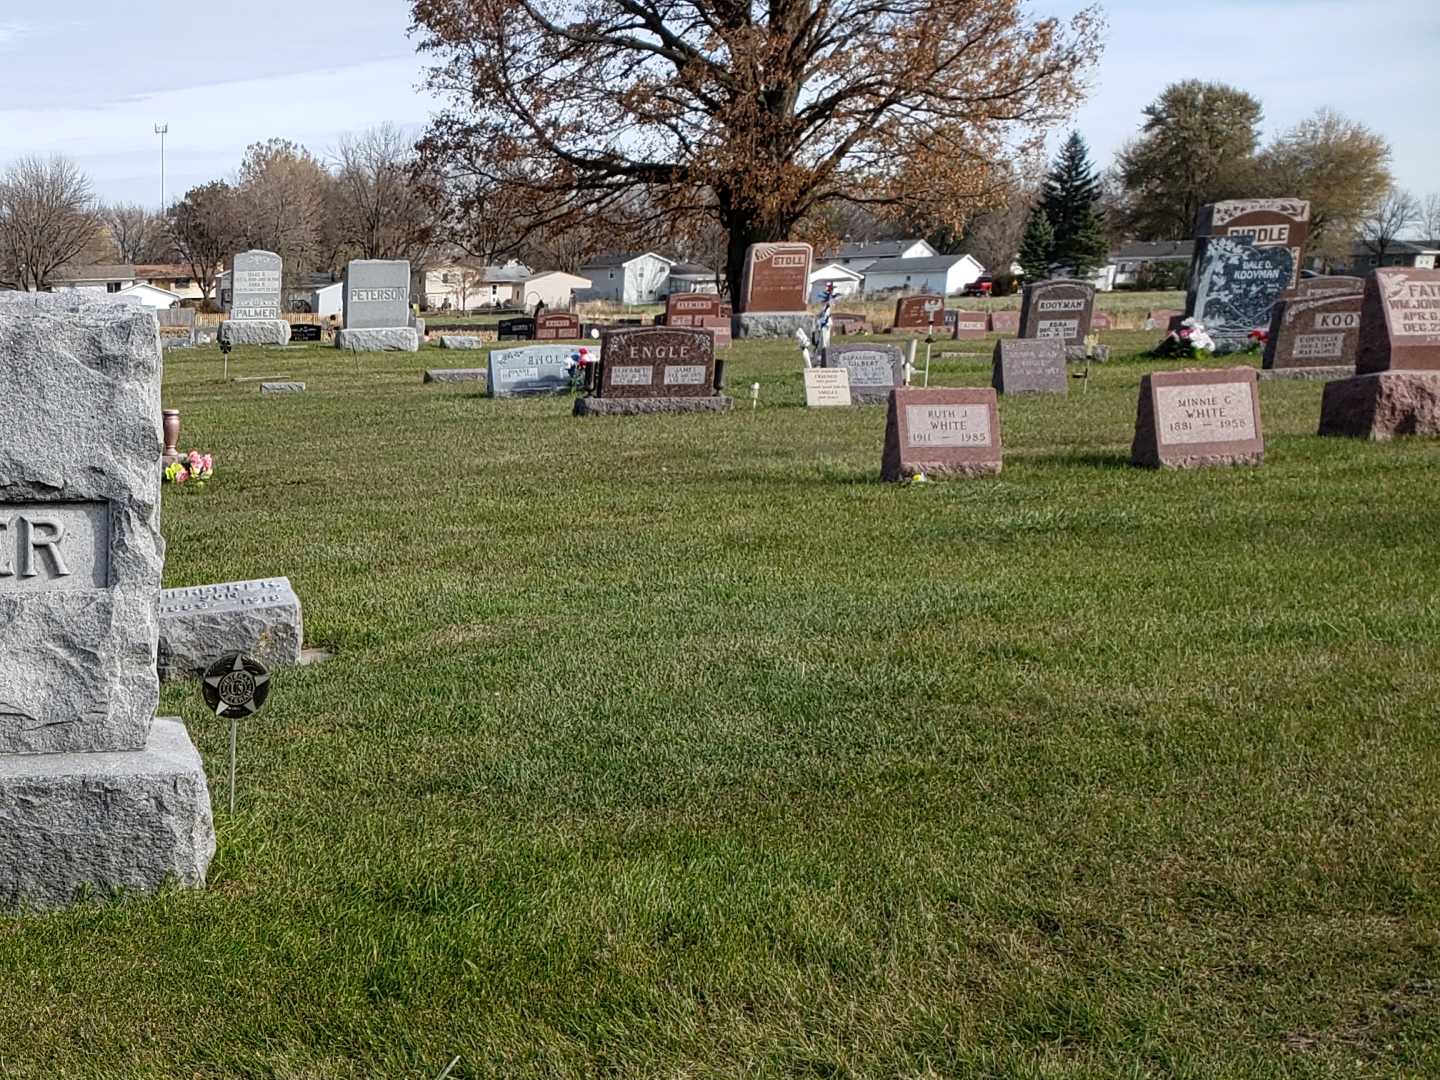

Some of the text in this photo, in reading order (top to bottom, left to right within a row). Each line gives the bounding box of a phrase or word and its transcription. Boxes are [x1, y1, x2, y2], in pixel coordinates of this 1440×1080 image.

[774, 257, 804, 265] STOLL
[1243, 261, 1273, 269] DALE D.
[1234, 270, 1280, 279] KOOYMAN
[351, 289, 405, 301] PETERSON
[1409, 285, 1440, 298] FAT
[1040, 301, 1083, 309] KOOYMAN
[236, 309, 275, 318] PALMER
[1321, 314, 1360, 327] KOO
[630, 346, 690, 358] ENGLE
[1178, 397, 1217, 407] MINNIE
[928, 410, 955, 418] RUTH
[1185, 408, 1227, 418] WHITE
[930, 421, 967, 430] WHITE
[1170, 422, 1192, 431] 1881
[1220, 419, 1246, 428] 1958
[961, 433, 986, 441] 1985
[230, 682, 244, 695] US
